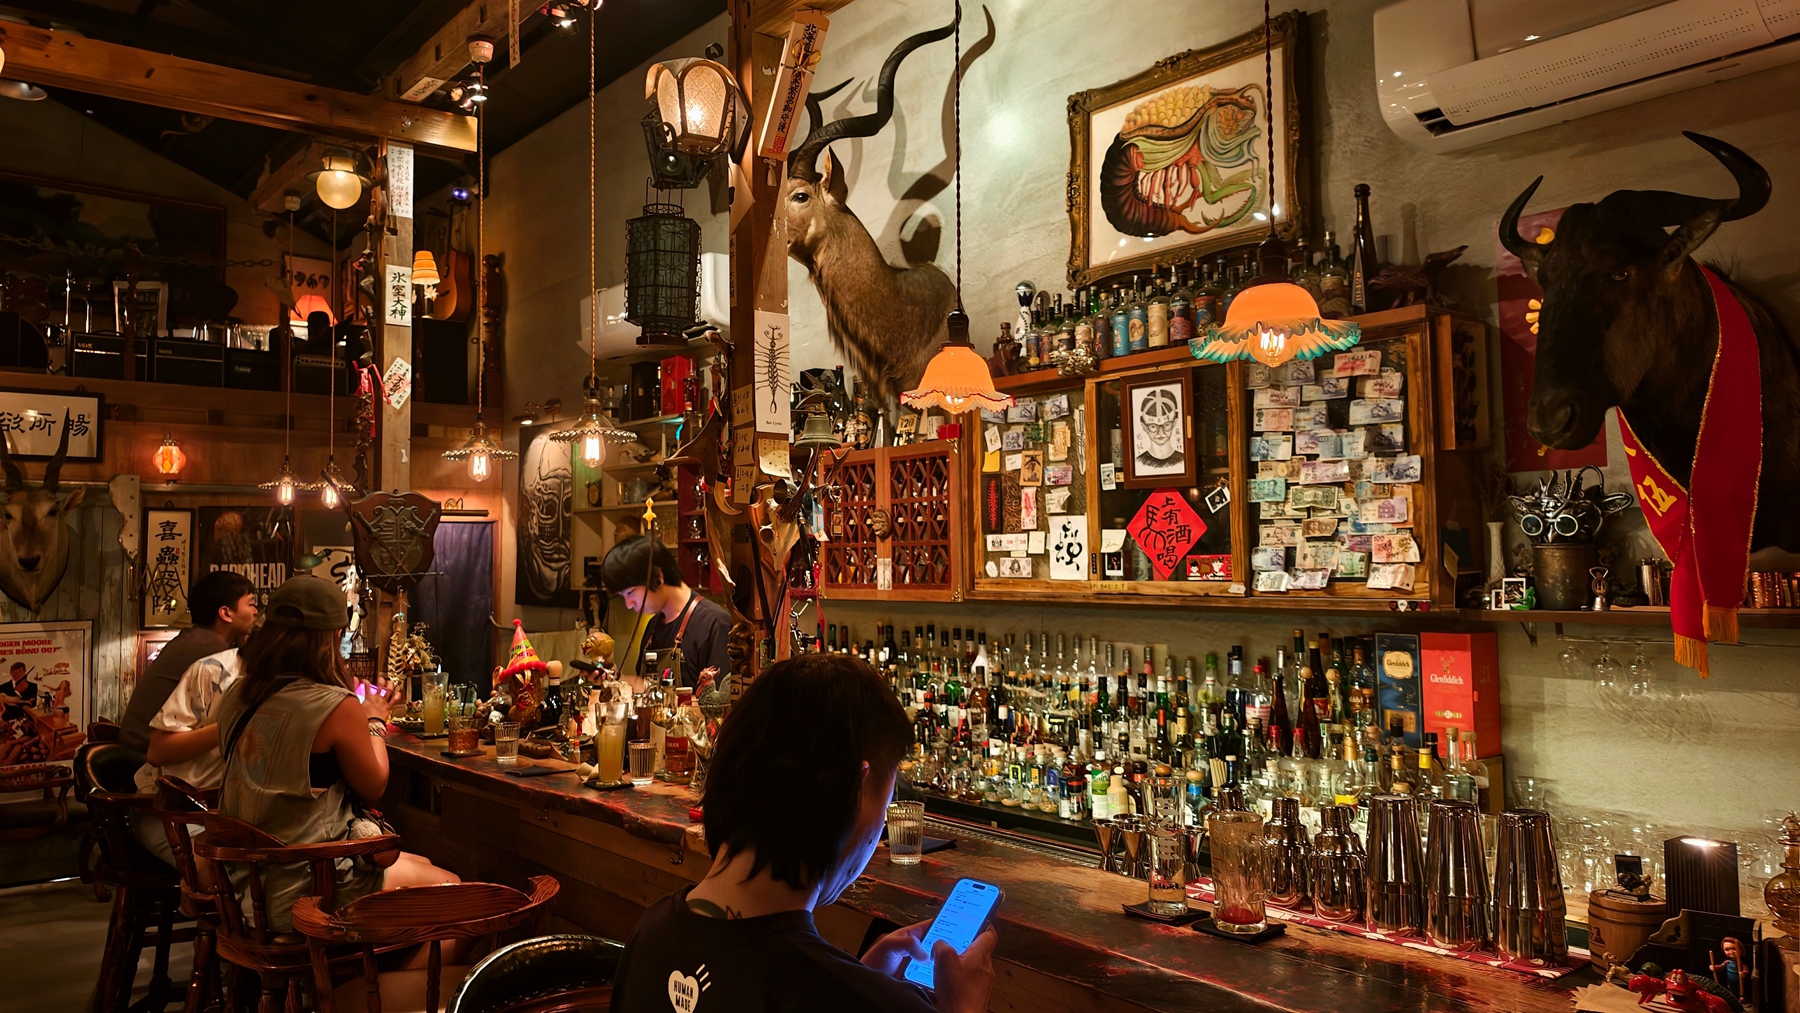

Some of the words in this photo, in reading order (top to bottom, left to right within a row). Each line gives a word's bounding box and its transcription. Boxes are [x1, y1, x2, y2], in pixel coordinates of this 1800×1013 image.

[1386, 659, 1410, 668] Glenfiddich
[1430, 673, 1464, 685] Glenfiddich
[673, 980, 694, 999] HUMAN
[675, 994, 691, 1012] MADE
